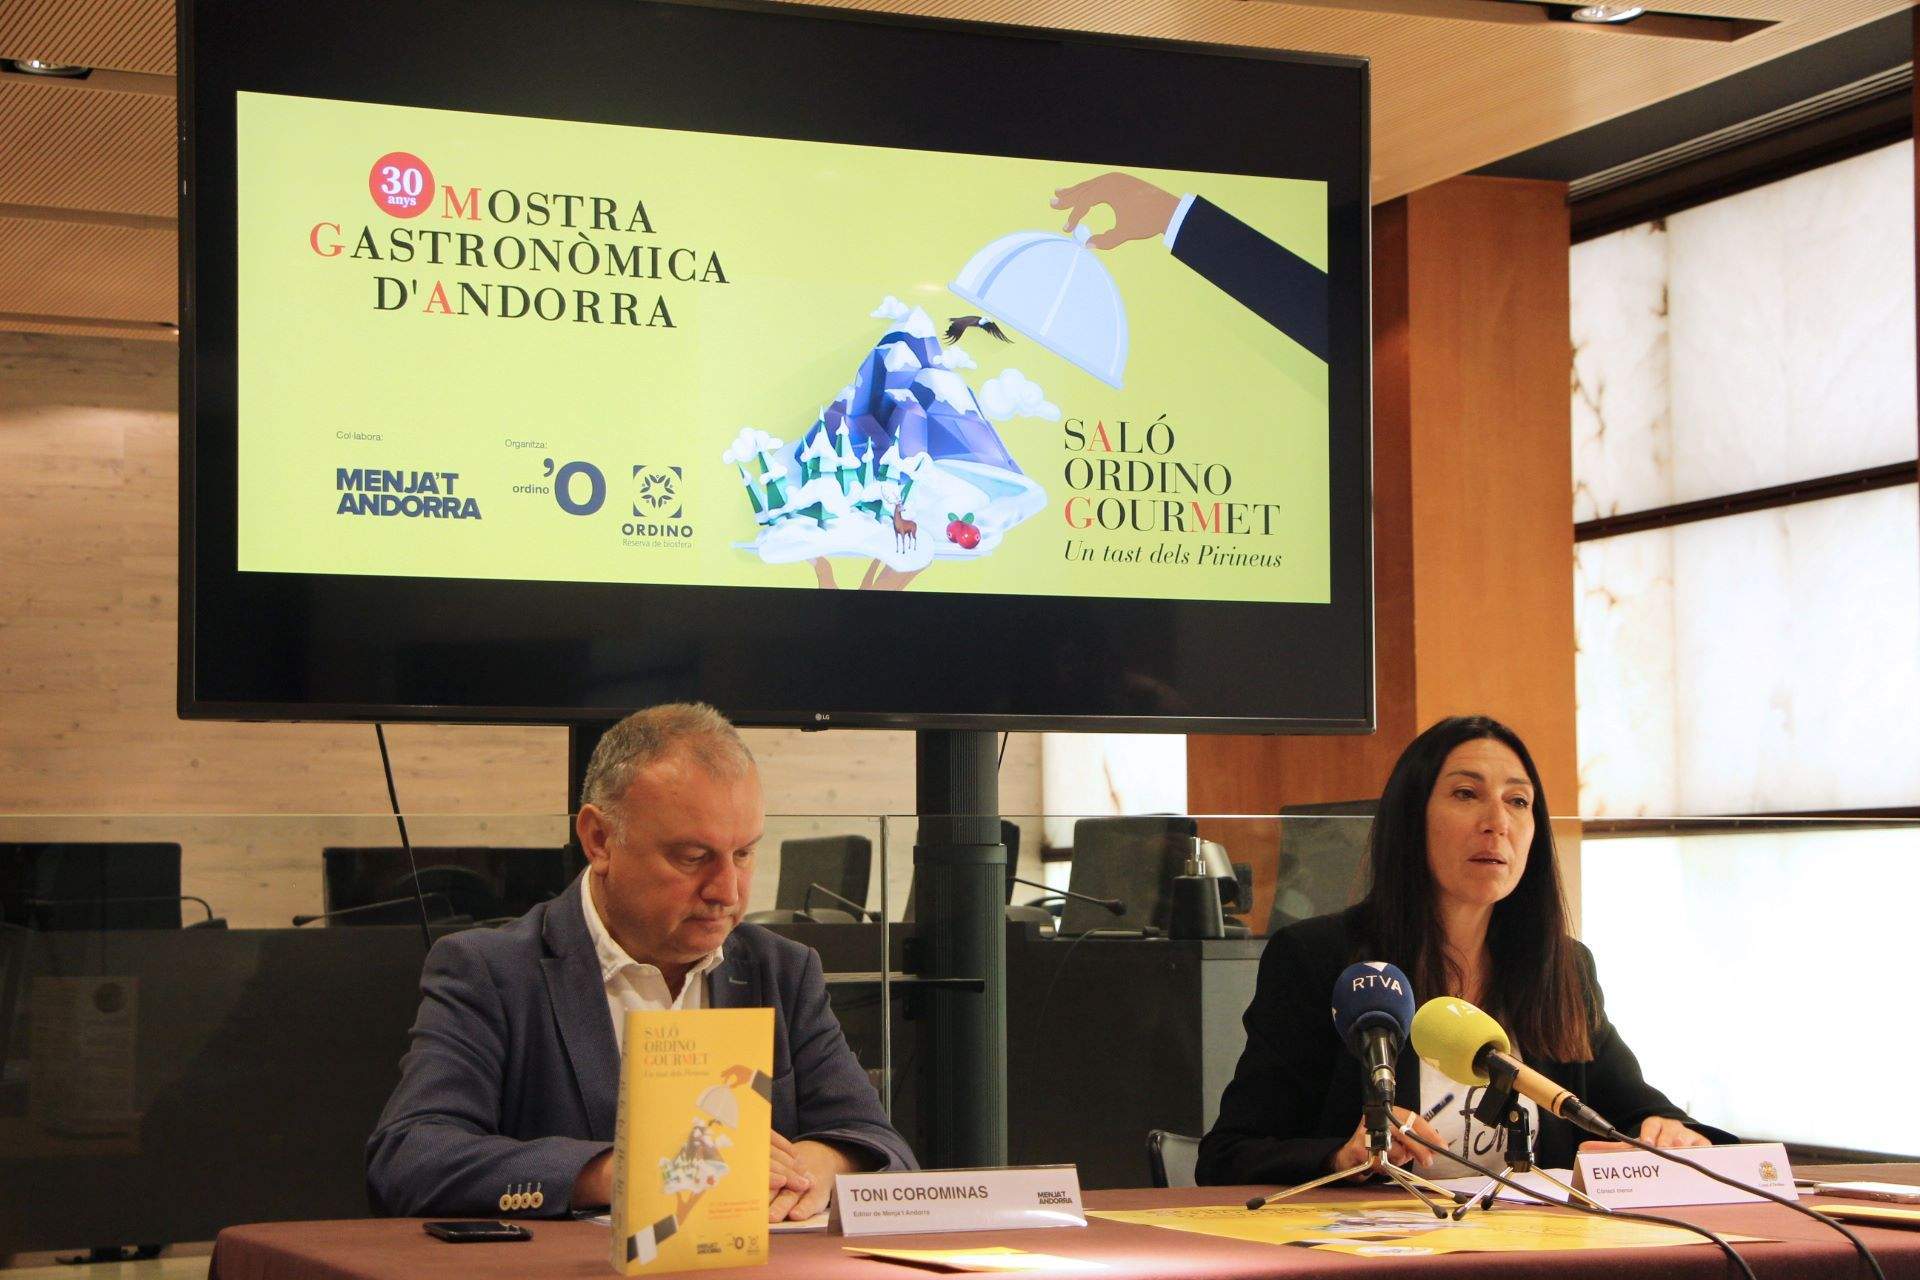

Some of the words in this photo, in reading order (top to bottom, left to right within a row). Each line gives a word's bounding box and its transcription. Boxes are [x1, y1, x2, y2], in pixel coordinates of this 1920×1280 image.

[380, 166, 423, 197] 30
[387, 194, 417, 208] anys
[440, 185, 657, 234] MOSTRA
[309, 222, 730, 284] GASTRONÒMICA
[373, 276, 677, 329] D'ANDORRA
[505, 438, 548, 450] Organitza:
[1064, 413, 1175, 455] SALÓ
[512, 482, 550, 495] ordino
[1064, 457, 1232, 496] ORDINO
[336, 492, 482, 520] ANDORRA
[1064, 496, 1281, 536] GOURMET
[622, 523, 693, 538] ORDINO
[622, 538, 651, 548] Reserva
[652, 539, 662, 548] de
[1064, 540, 1094, 562] Un
[1103, 544, 1142, 563] tast
[1150, 543, 1190, 565] dels
[1198, 544, 1282, 568] Pirineus
[1352, 974, 1403, 996] RTVA
[1592, 1167, 1620, 1180] EVA
[1622, 1165, 1660, 1179] CHOY
[850, 1187, 888, 1202] TONI
[893, 1185, 989, 1202] COROMINAS
